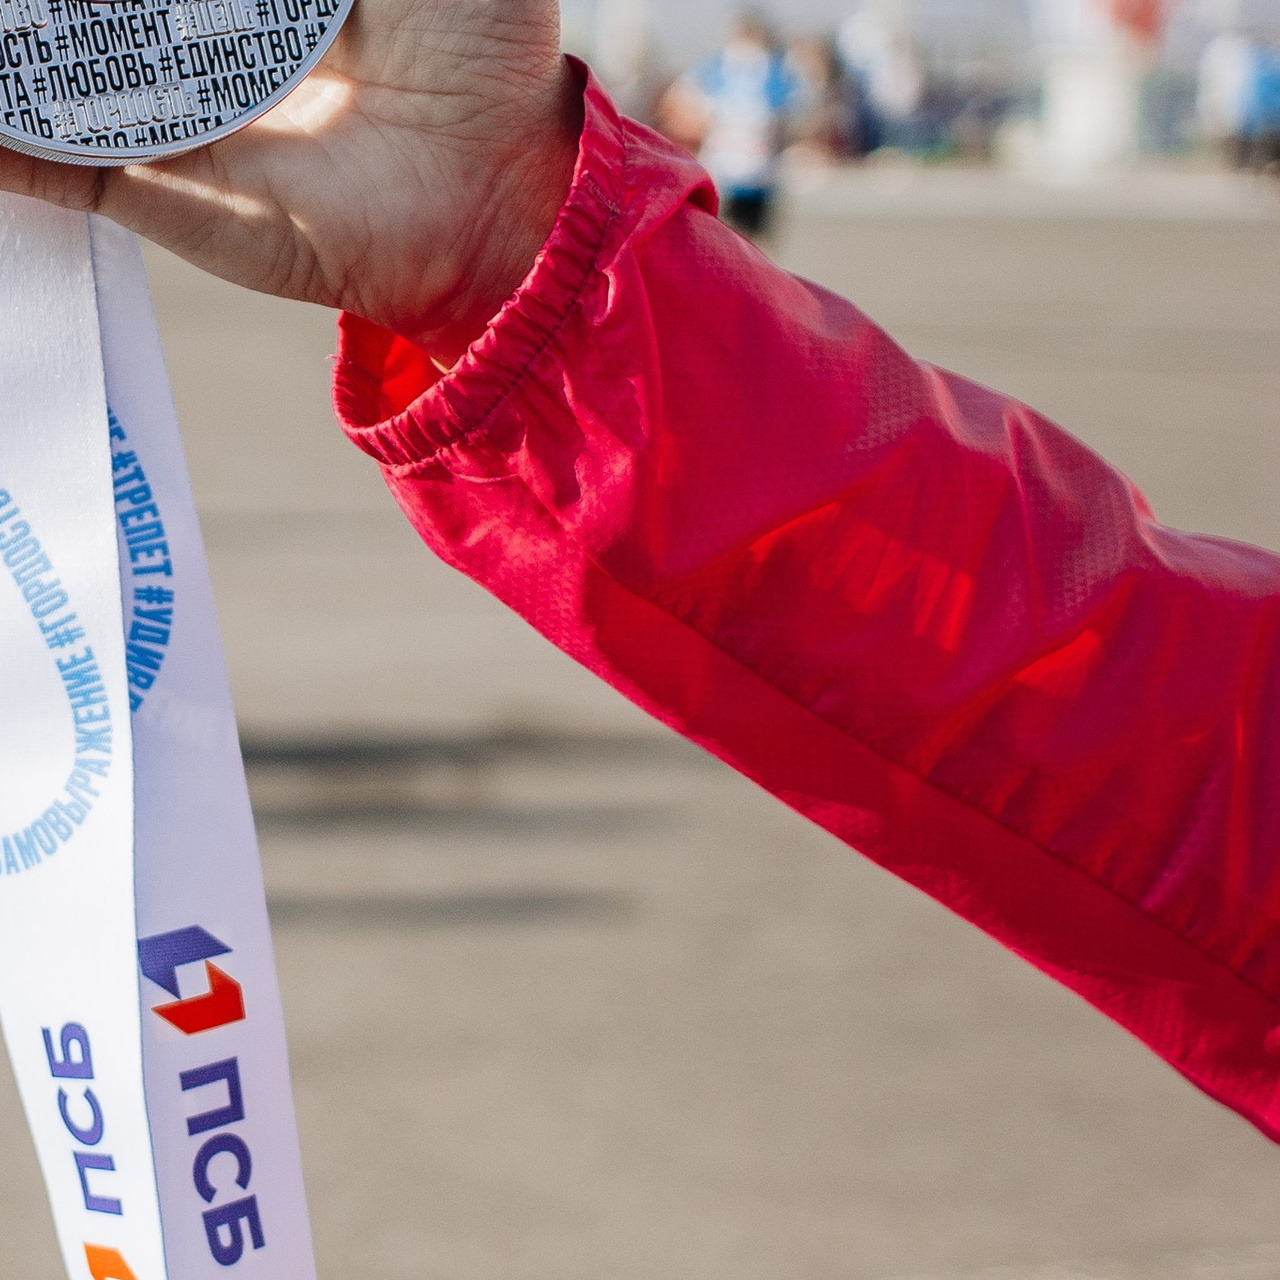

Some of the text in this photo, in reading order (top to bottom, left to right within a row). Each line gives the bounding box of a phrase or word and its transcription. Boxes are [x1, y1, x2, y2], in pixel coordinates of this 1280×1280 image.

[32, 51, 157, 105] #ЛЮБОВЬ
[159, 26, 303, 83] #ЕДИНСТВО
[54, 9, 172, 62] #МОМЕНТ
[41, 1022, 123, 1216] ПСБ
[179, 1056, 265, 1266] ПСБ
